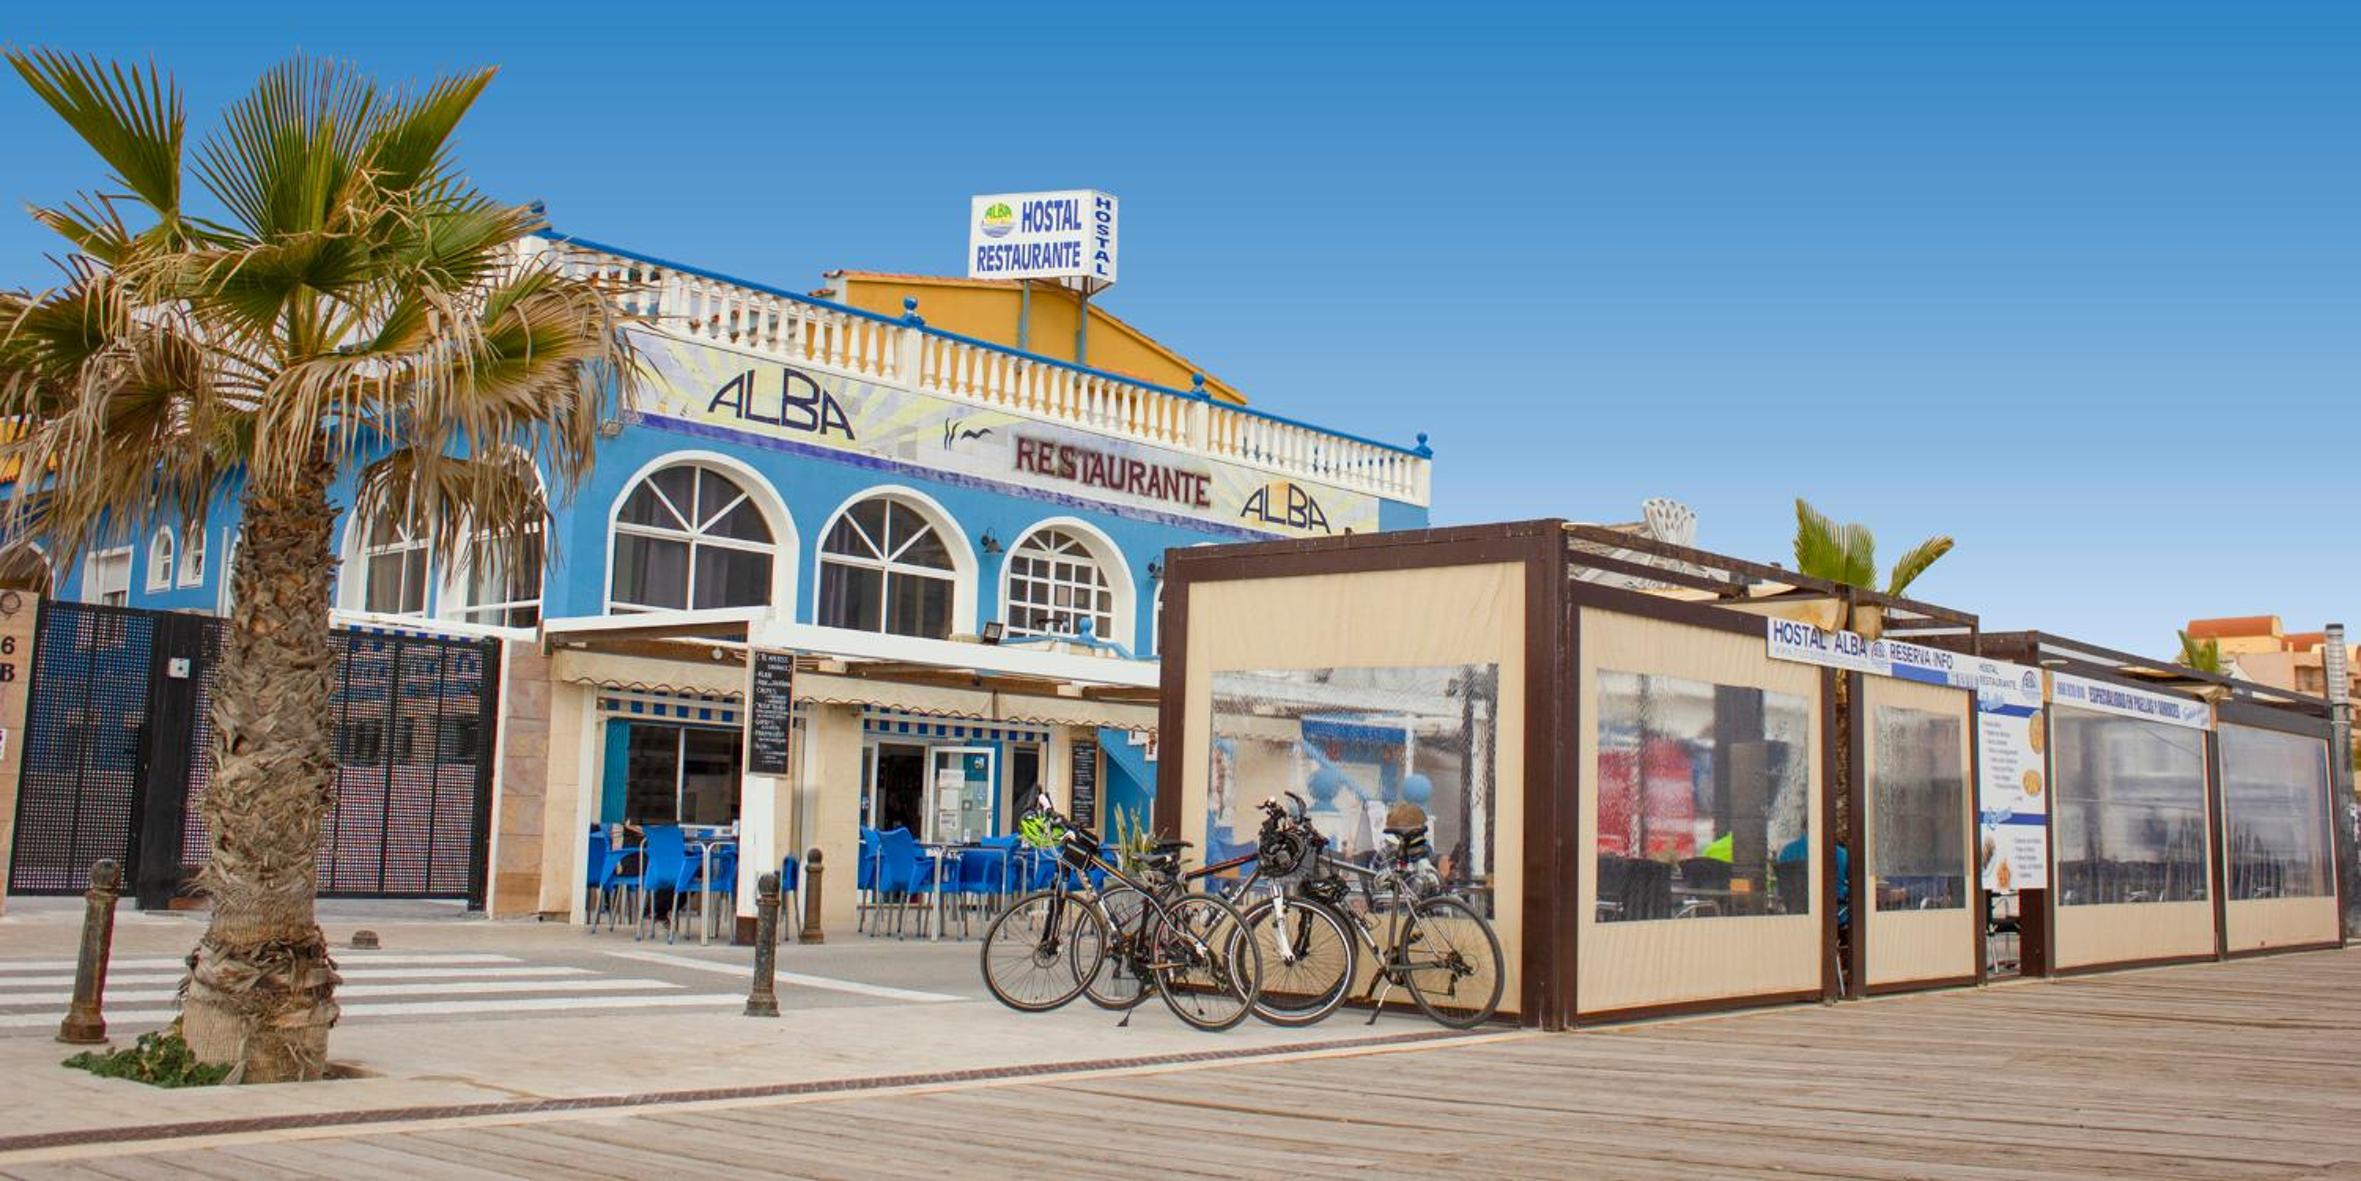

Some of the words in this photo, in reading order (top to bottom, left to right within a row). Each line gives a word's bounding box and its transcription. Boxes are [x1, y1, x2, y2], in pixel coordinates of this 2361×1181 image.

[985, 203, 1012, 218] ALBA
[1021, 199, 1082, 233] HOSTAL
[1094, 197, 1111, 276] HOSTAL
[977, 241, 1081, 272] RESTAURANTE
[707, 368, 855, 440] ALBA
[1016, 437, 1211, 507] RESTAURANTE
[1240, 483, 1331, 534] ALBA
[1, 636, 15, 655] 6
[1774, 620, 1827, 650] HOSTAL
[1834, 630, 1867, 657] ALBA
[0, 663, 16, 682] B
[1890, 643, 1931, 665] RESERVA
[1932, 651, 1953, 669] INFO
